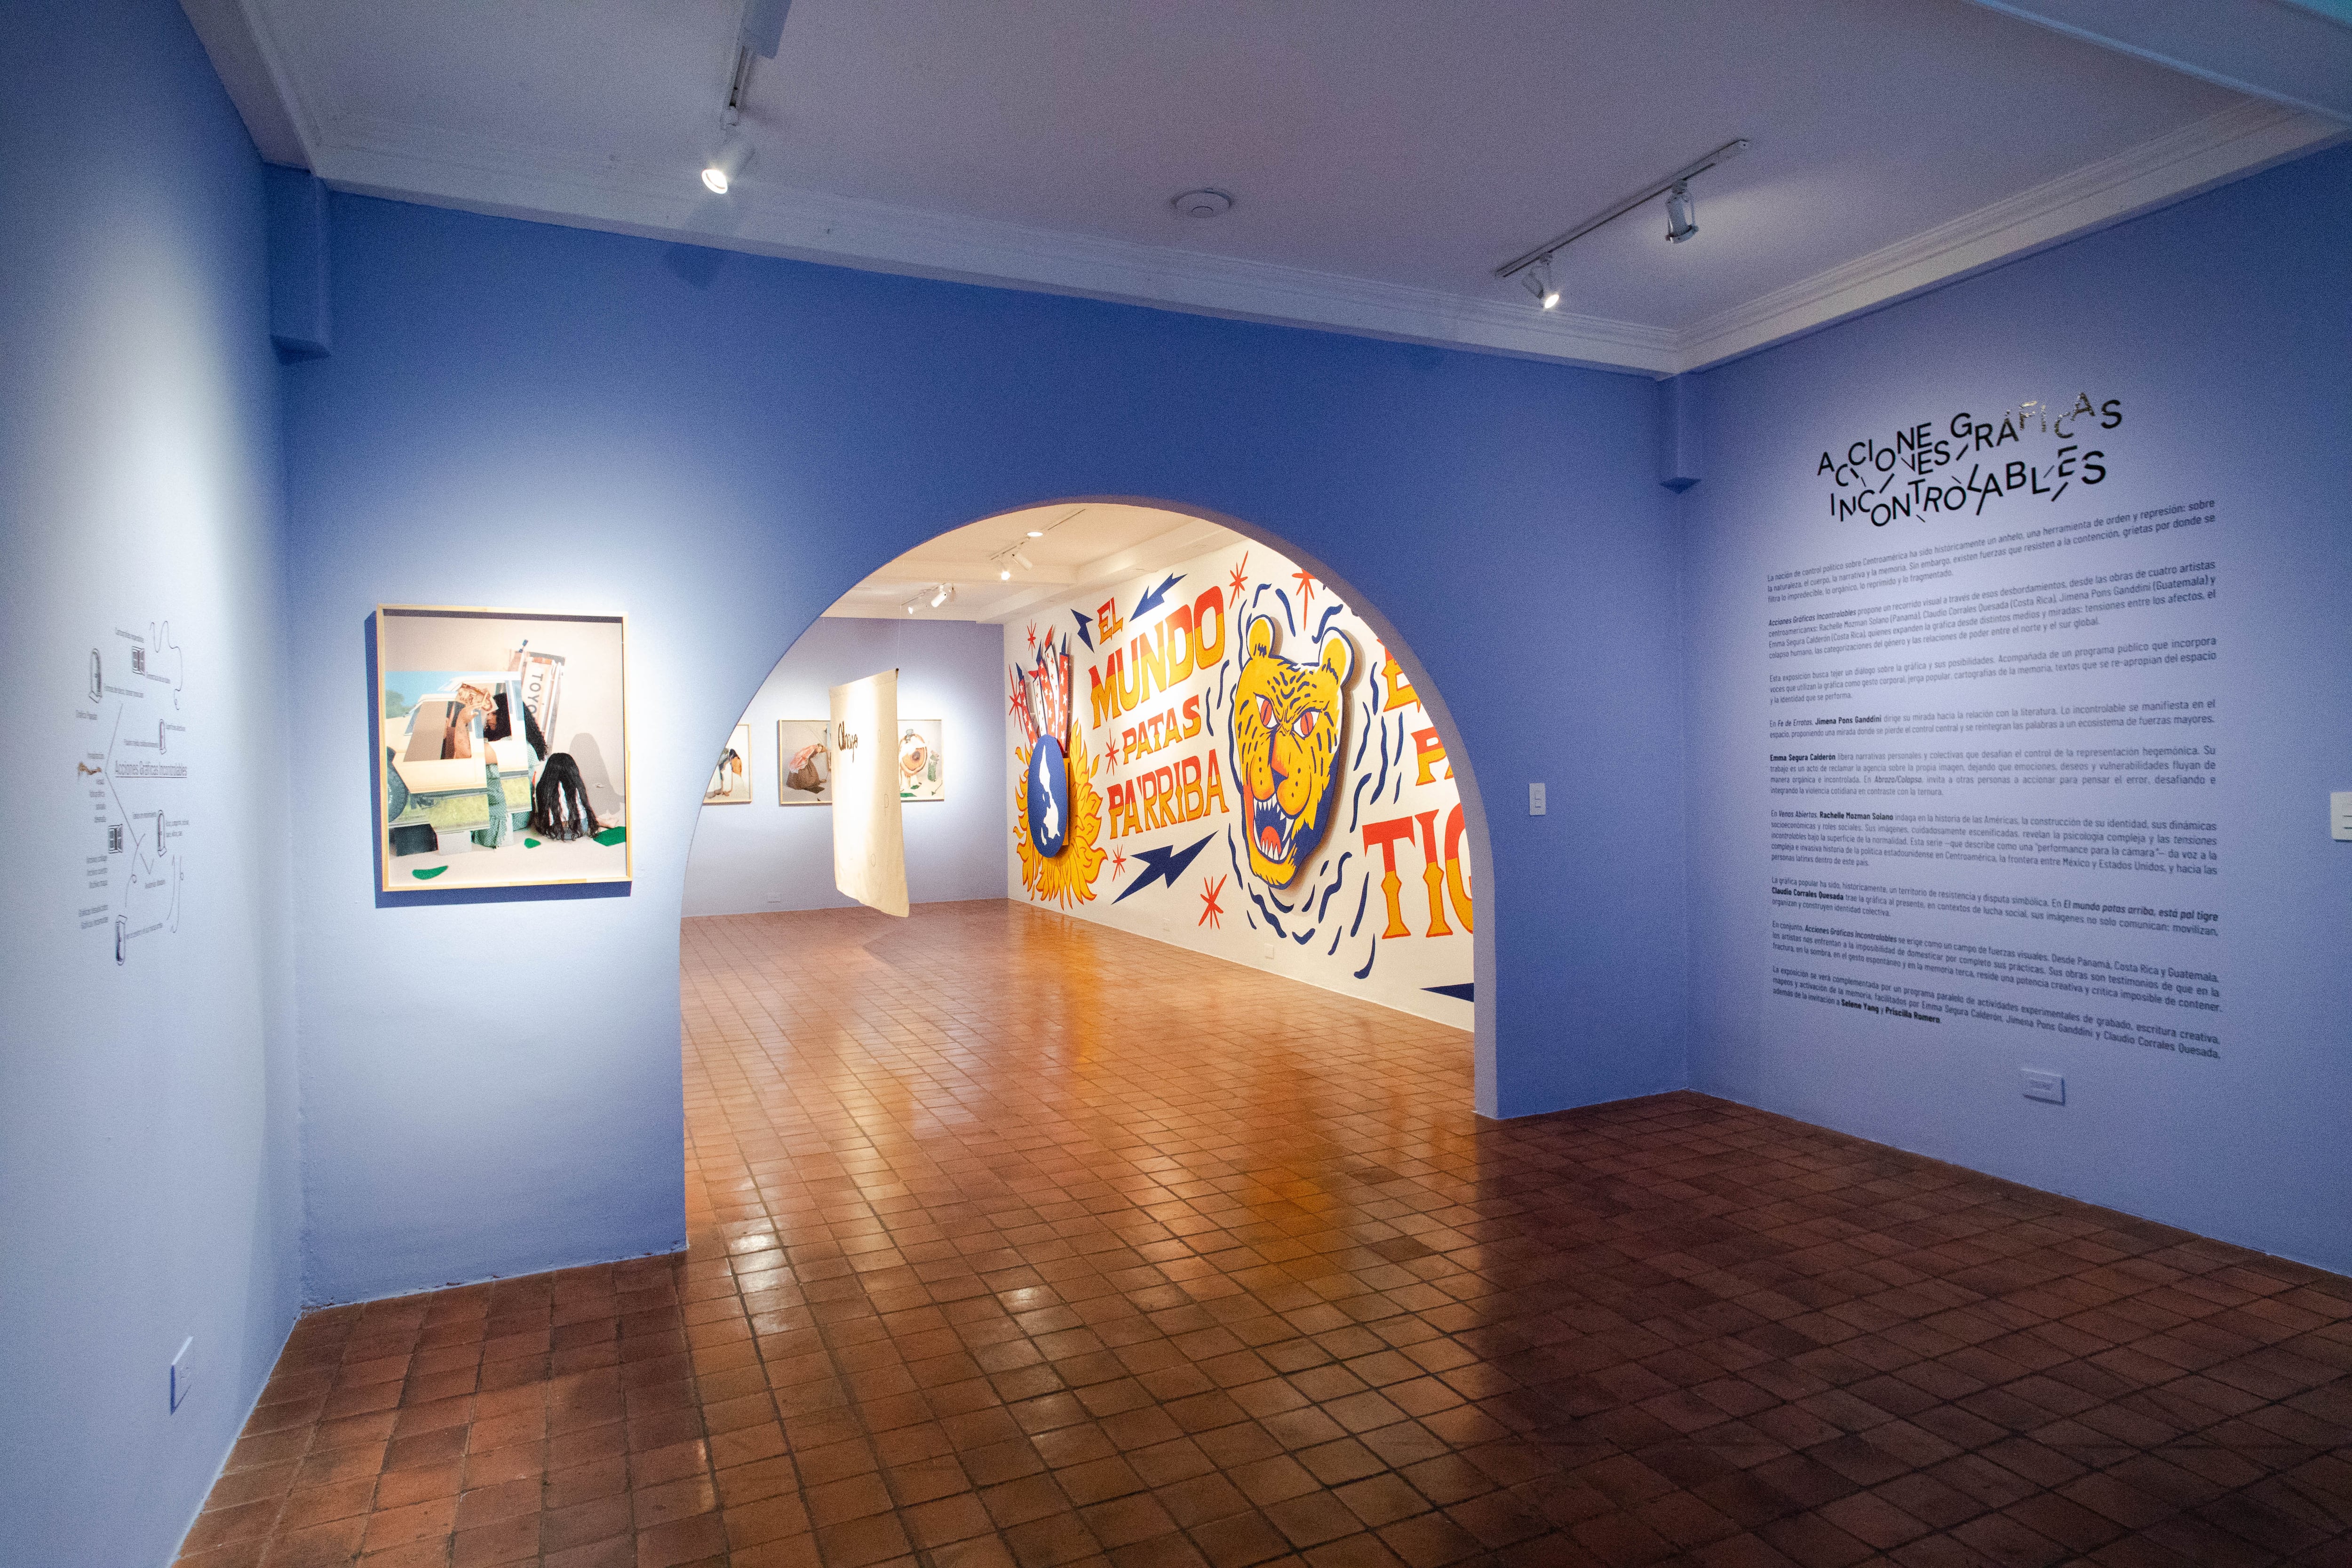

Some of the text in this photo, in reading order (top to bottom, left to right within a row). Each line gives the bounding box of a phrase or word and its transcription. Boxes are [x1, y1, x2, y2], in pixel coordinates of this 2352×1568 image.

[1831, 446, 2106, 526] INCONTROLABLES
[1817, 608, 1856, 620] Incontrolables
[1858, 606, 1881, 616] propone
[1893, 599, 1921, 610] recorrido
[1923, 596, 1941, 606] visual
[2070, 576, 2092, 587] desde
[2109, 572, 2132, 581] obras
[2148, 565, 2177, 577] cuatro
[2180, 561, 2216, 573] artistas
[1820, 621, 1842, 631] Rachelle
[1869, 616, 1888, 625] Solano
[1923, 608, 1947, 618] Claudio
[1949, 605, 1976, 615] Corrales
[1979, 601, 2008, 613] Quesada
[2059, 592, 2089, 602] Jimena
[2091, 589, 2111, 597] Pons
[2153, 575, 2208, 592] (Guatemala)
[1097, 597, 1124, 645] EL
[1832, 632, 1849, 642] (Costa
[1868, 629, 1891, 638] quienes
[1893, 624, 1923, 635] expanden
[1958, 617, 1978, 627] desde
[2013, 610, 2040, 620] medios
[2085, 601, 2125, 612] tensiones
[2127, 597, 2150, 607] entre
[1088, 585, 1225, 730] MUNDO
[1122, 694, 1202, 765] PATAS
[1855, 715, 1882, 723] Ganddini
[1410, 727, 1454, 787] P
[1788, 754, 1808, 762] Segura
[1772, 886, 1791, 895] Claudio
[1793, 888, 1817, 898] Corrales
[1819, 891, 1843, 900] Quesada
[1841, 998, 1861, 1009] Selene
[1864, 1002, 1879, 1014] Yang
[1885, 1006, 1912, 1018] Priscilla
